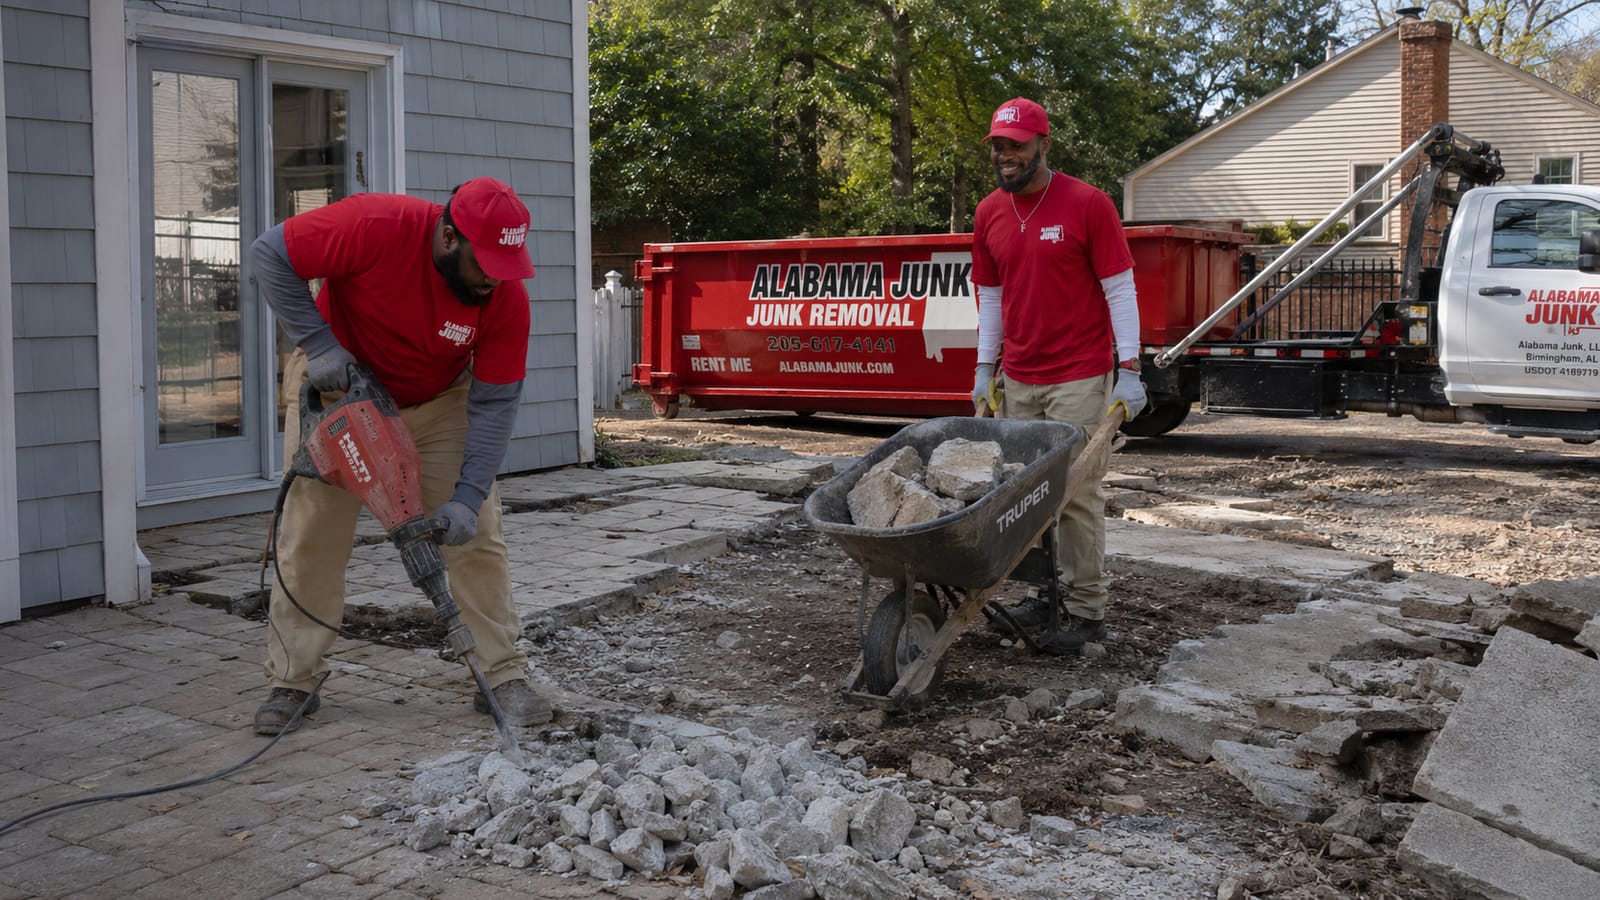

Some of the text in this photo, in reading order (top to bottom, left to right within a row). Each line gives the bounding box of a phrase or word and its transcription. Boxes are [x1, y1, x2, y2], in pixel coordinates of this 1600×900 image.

[499, 233, 525, 246] JUNK
[1040, 231, 1060, 240] JUNK
[749, 261, 972, 300] ALABAMA JUNK
[1527, 289, 1600, 304] ALABAMA
[746, 303, 914, 327] JUNK REMOVAL
[1525, 303, 1598, 325] JUNK
[438, 327, 467, 343] JUNK
[767, 335, 896, 353] 205-617-4141
[1518, 340, 1559, 350] Alabama
[1560, 342, 1586, 352] Junk,
[691, 357, 753, 373] RENT ME
[1525, 353, 1598, 364] Birmingham, AL
[779, 361, 894, 375] ALABAMAJUNK.COM
[1524, 366, 1557, 375] USDOT
[343, 432, 371, 483] HILTI
[997, 481, 1049, 533] TRUPER
